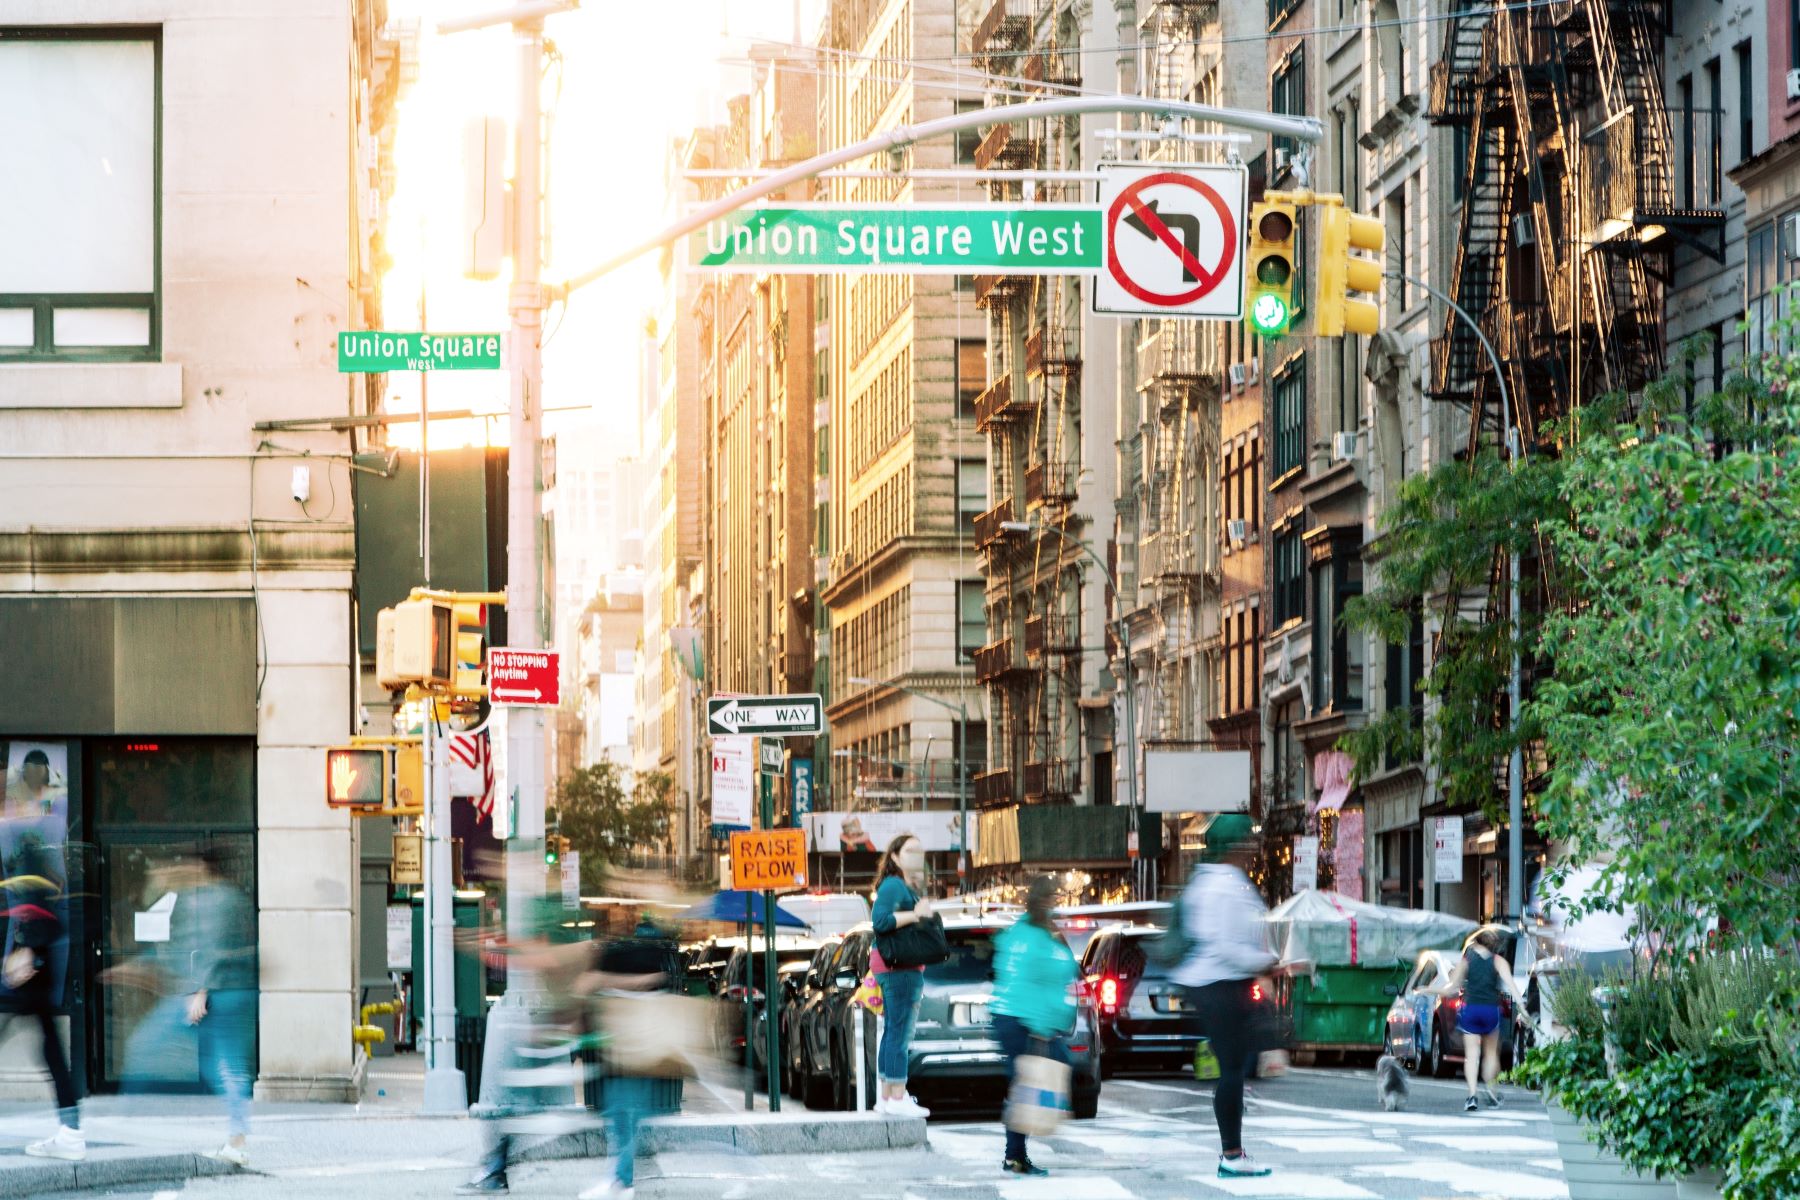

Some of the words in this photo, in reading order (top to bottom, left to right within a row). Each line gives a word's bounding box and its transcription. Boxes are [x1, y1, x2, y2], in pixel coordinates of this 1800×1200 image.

[707, 217, 817, 256] Union
[837, 219, 972, 263] Square
[992, 220, 1085, 256] West
[344, 333, 409, 358] Union
[419, 335, 498, 362] Square
[407, 358, 436, 371] West
[493, 654, 506, 667] NO
[507, 654, 548, 669] STOPPING
[494, 667, 528, 681] Anytime
[723, 710, 756, 724] ONE
[775, 708, 810, 722] WAY
[795, 767, 809, 813] PARK
[741, 839, 799, 859] RAISE
[743, 861, 796, 879] PLOW
